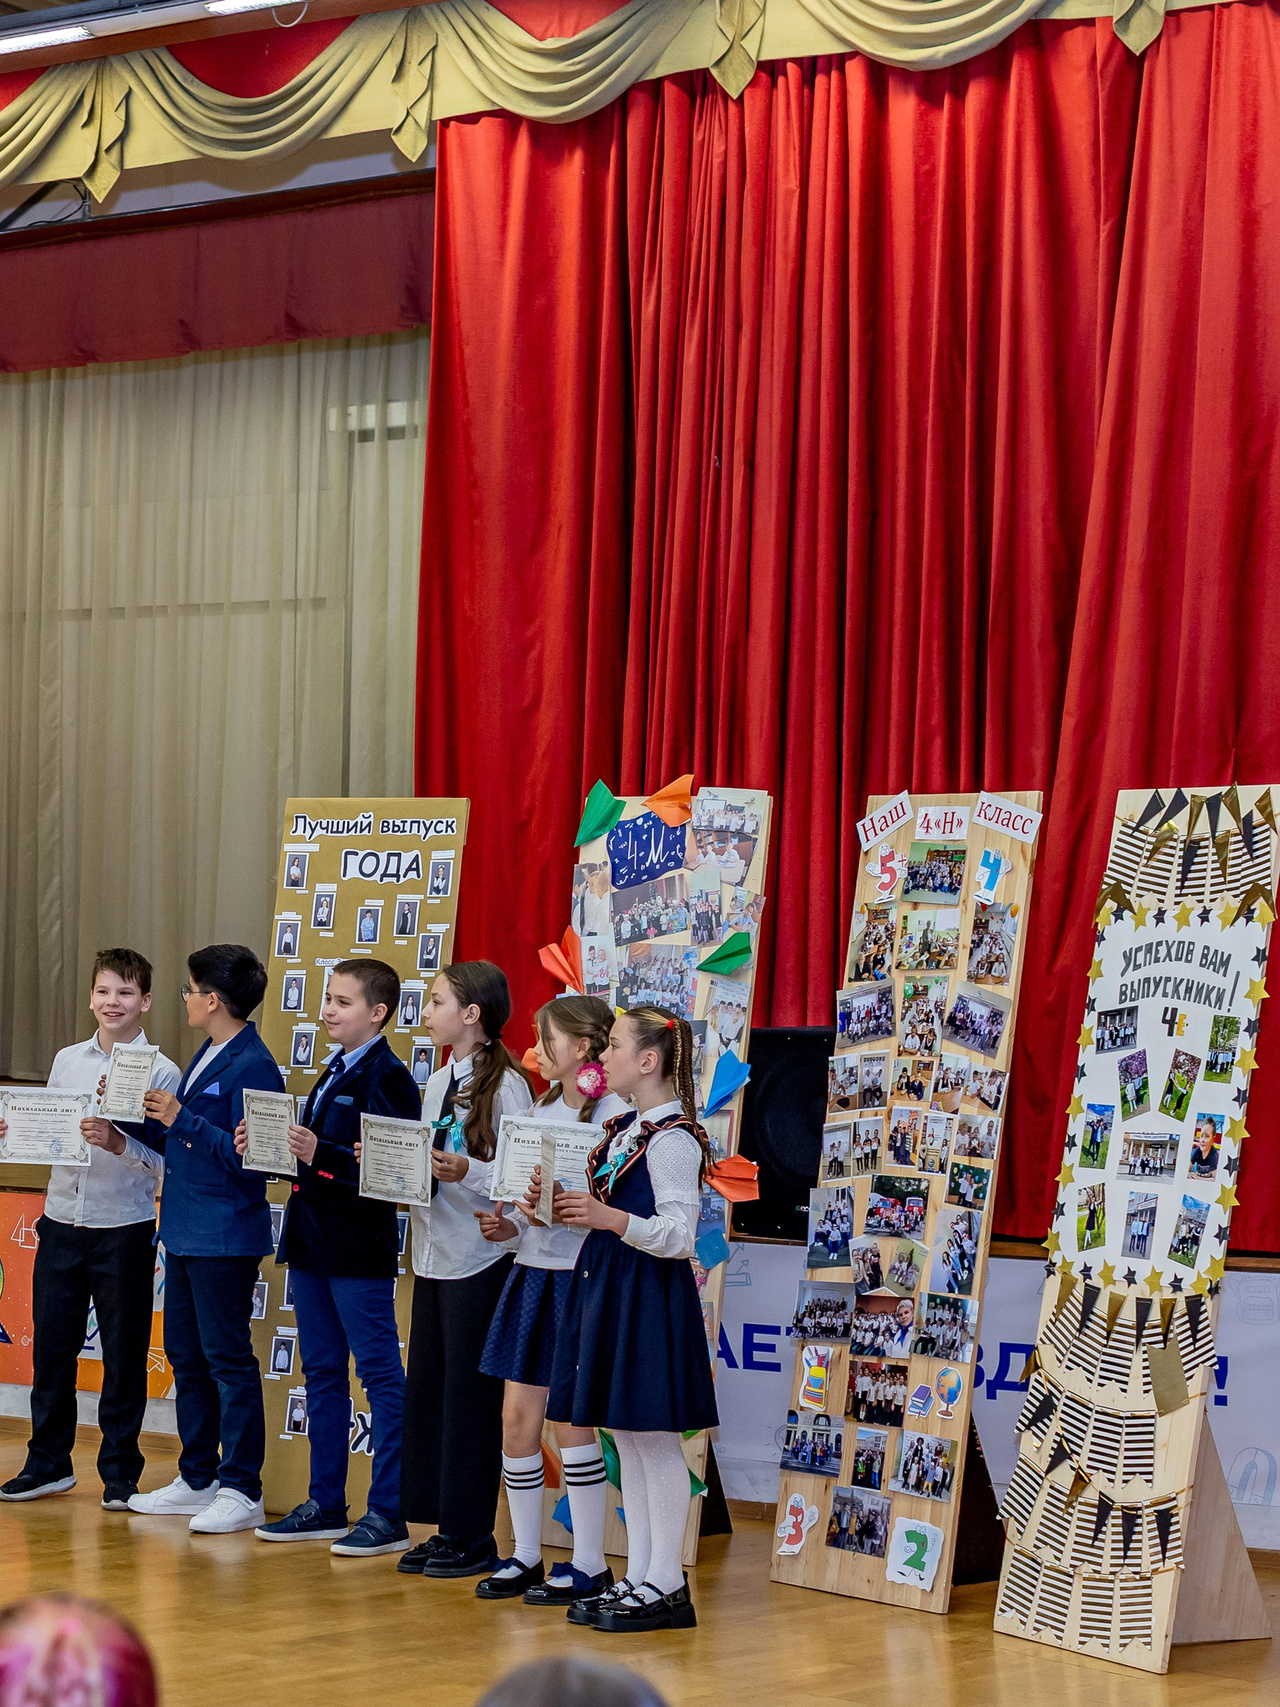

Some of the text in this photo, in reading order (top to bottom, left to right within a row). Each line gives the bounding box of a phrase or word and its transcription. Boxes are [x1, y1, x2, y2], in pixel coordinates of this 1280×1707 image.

[291, 814, 456, 841] Лучший выпуск
[861, 800, 907, 843] Наш
[976, 801, 1034, 836] класс
[342, 850, 422, 884] ГОДА
[1120, 939, 1233, 979] УСПЕХОВ ВАМ
